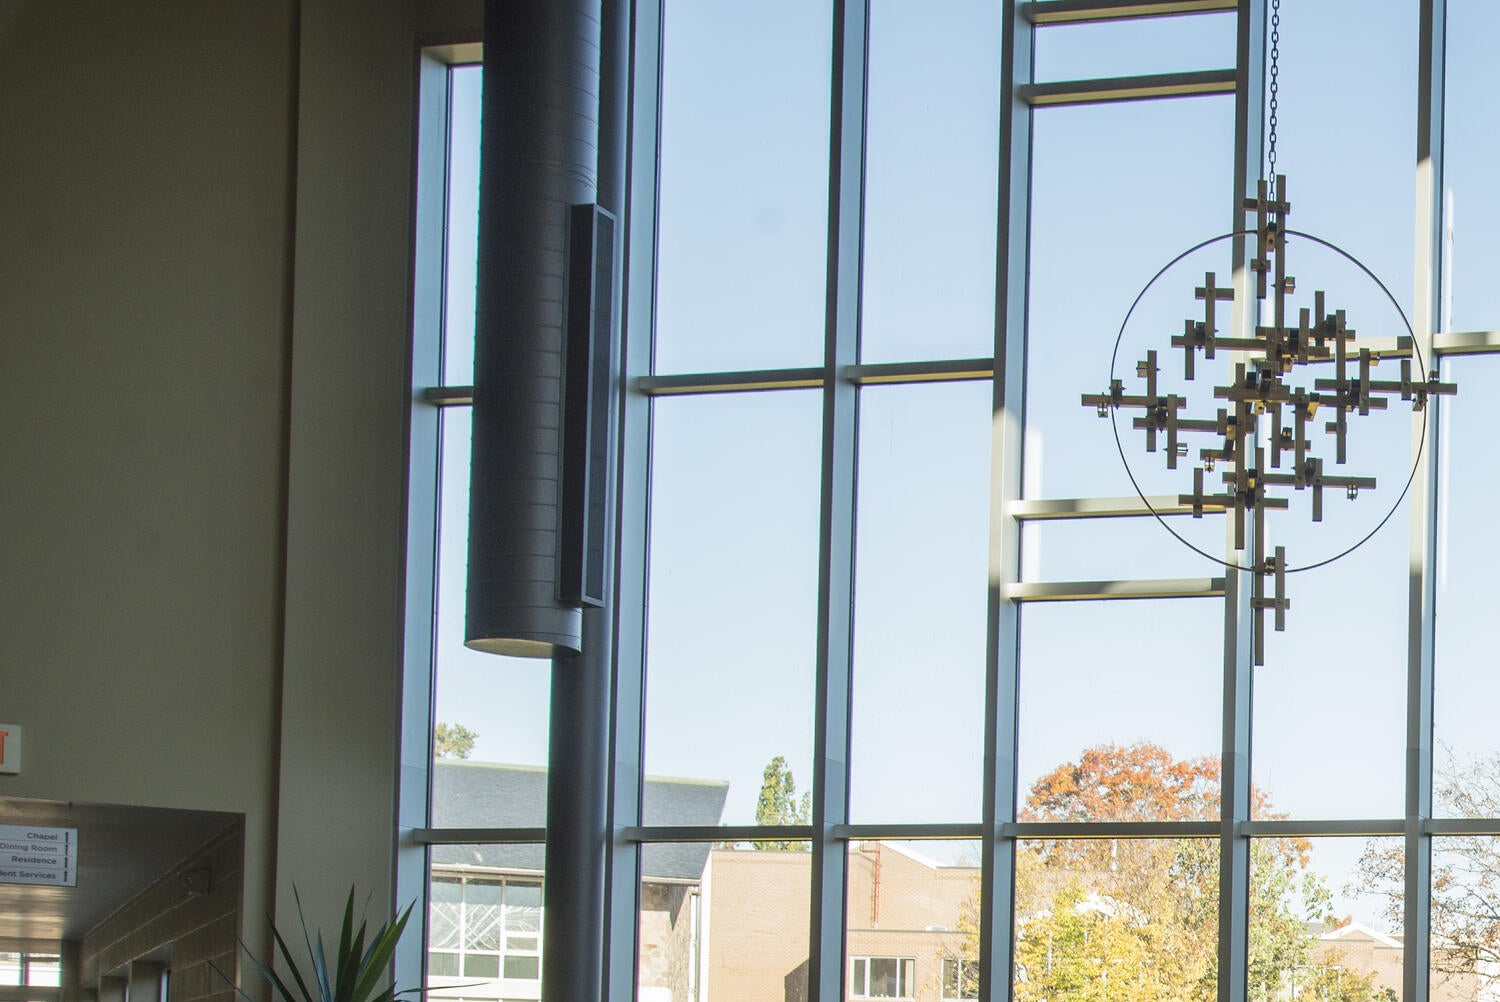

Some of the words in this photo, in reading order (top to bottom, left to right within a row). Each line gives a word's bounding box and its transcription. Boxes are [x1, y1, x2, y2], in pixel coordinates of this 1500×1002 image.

[27, 832, 58, 841] Chapel
[0, 842, 29, 851] Dining
[31, 844, 58, 852] Room
[11, 855, 57, 864] Residence
[19, 870, 56, 879] Services
